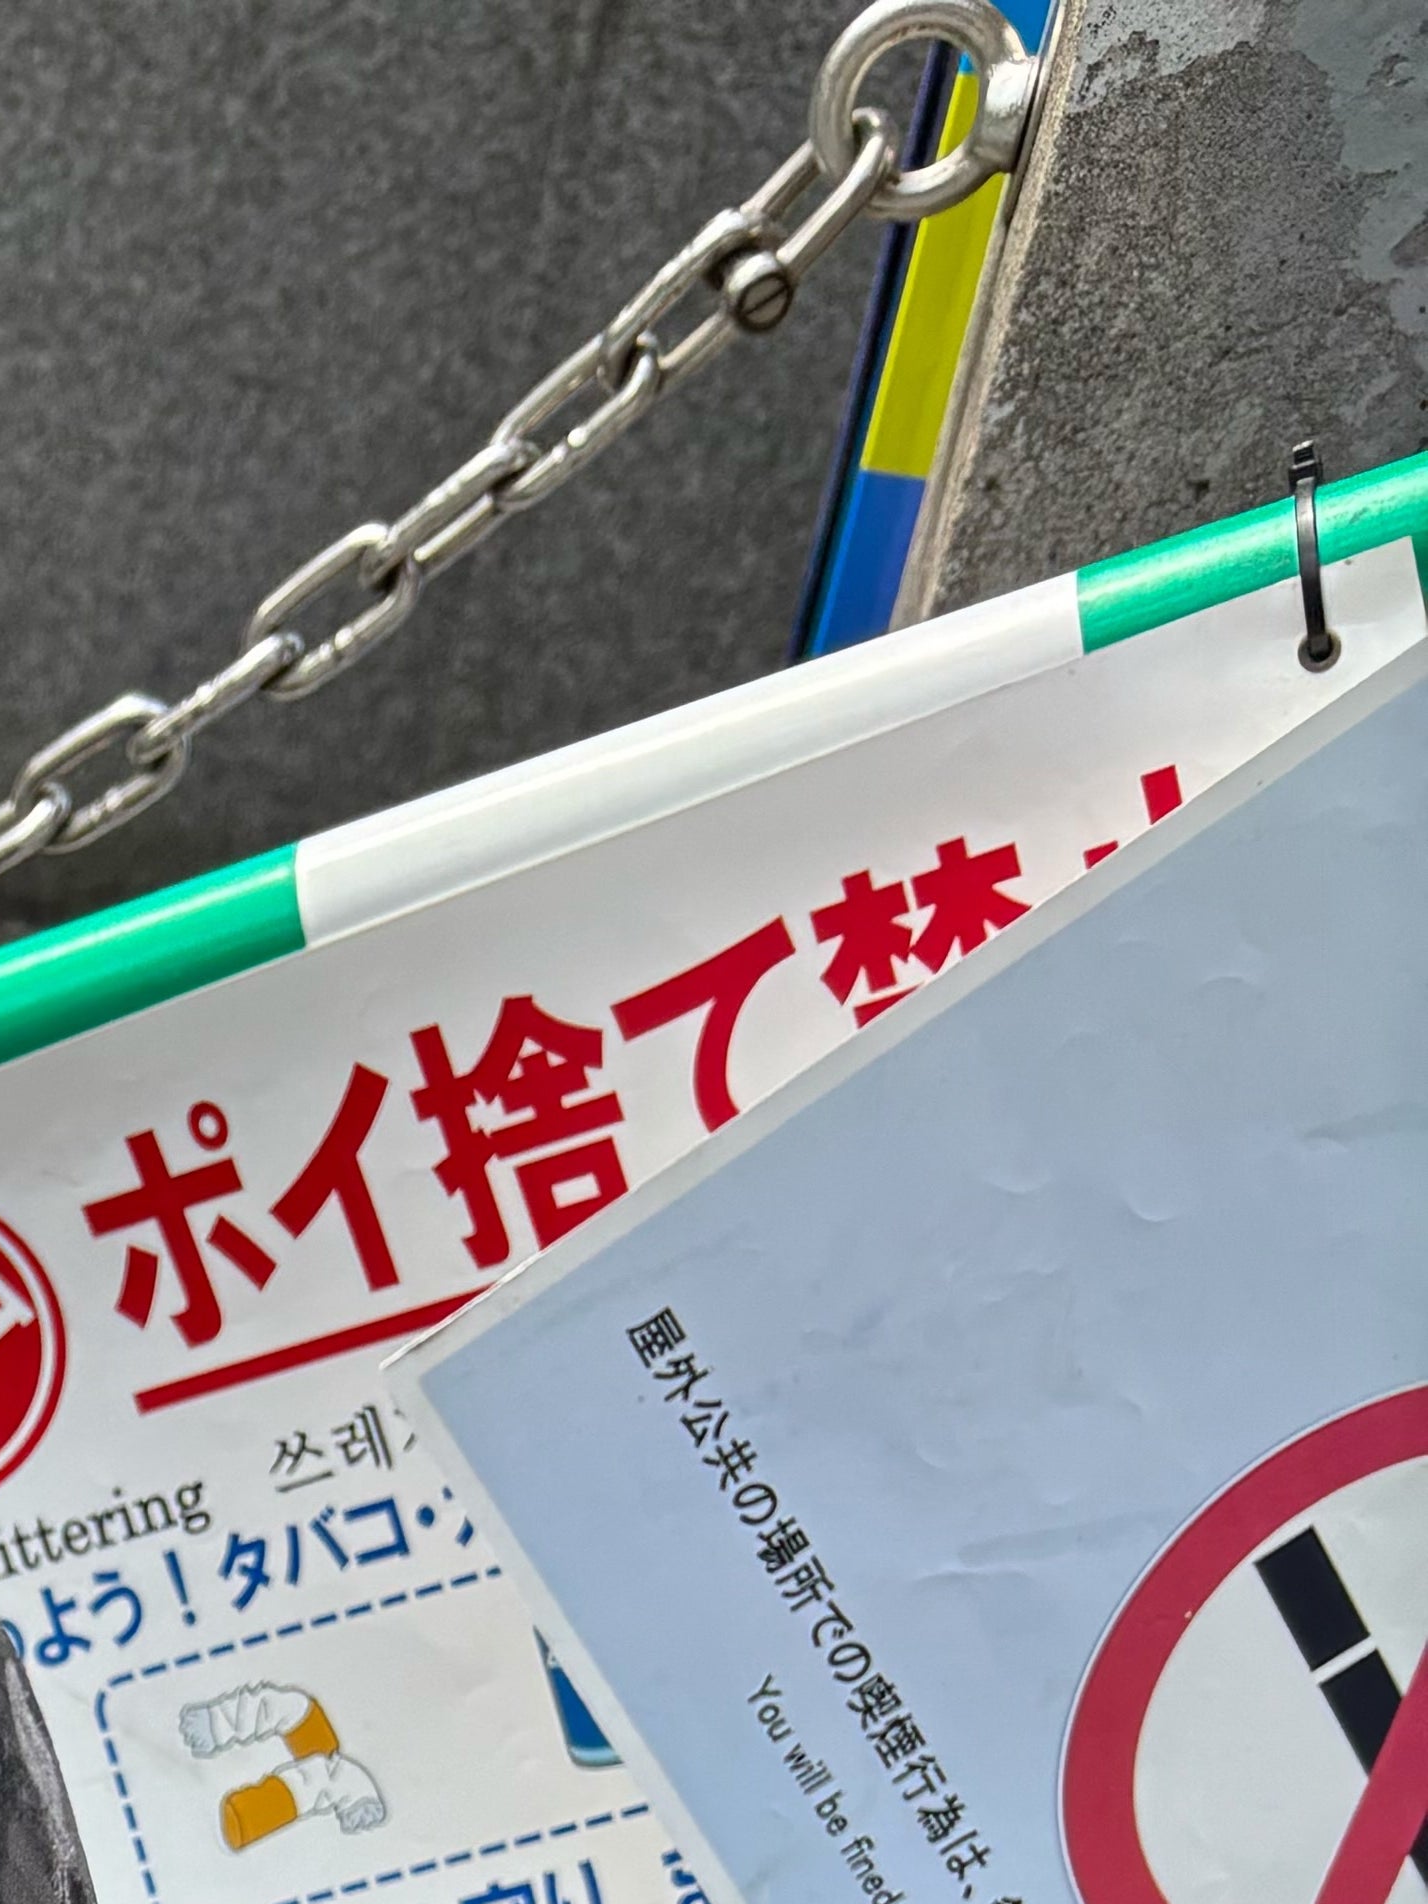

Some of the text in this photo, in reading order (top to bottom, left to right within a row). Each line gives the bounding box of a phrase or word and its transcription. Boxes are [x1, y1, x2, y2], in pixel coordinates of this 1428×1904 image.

[82, 765, 1184, 1349] ポイ捨て禁
[269, 1405, 415, 1492] 쓰레
[2, 1485, 474, 1667] よう！タバコ・
[748, 1673, 794, 1743] You
[784, 1743, 834, 1795] will
[814, 1790, 848, 1837] be
